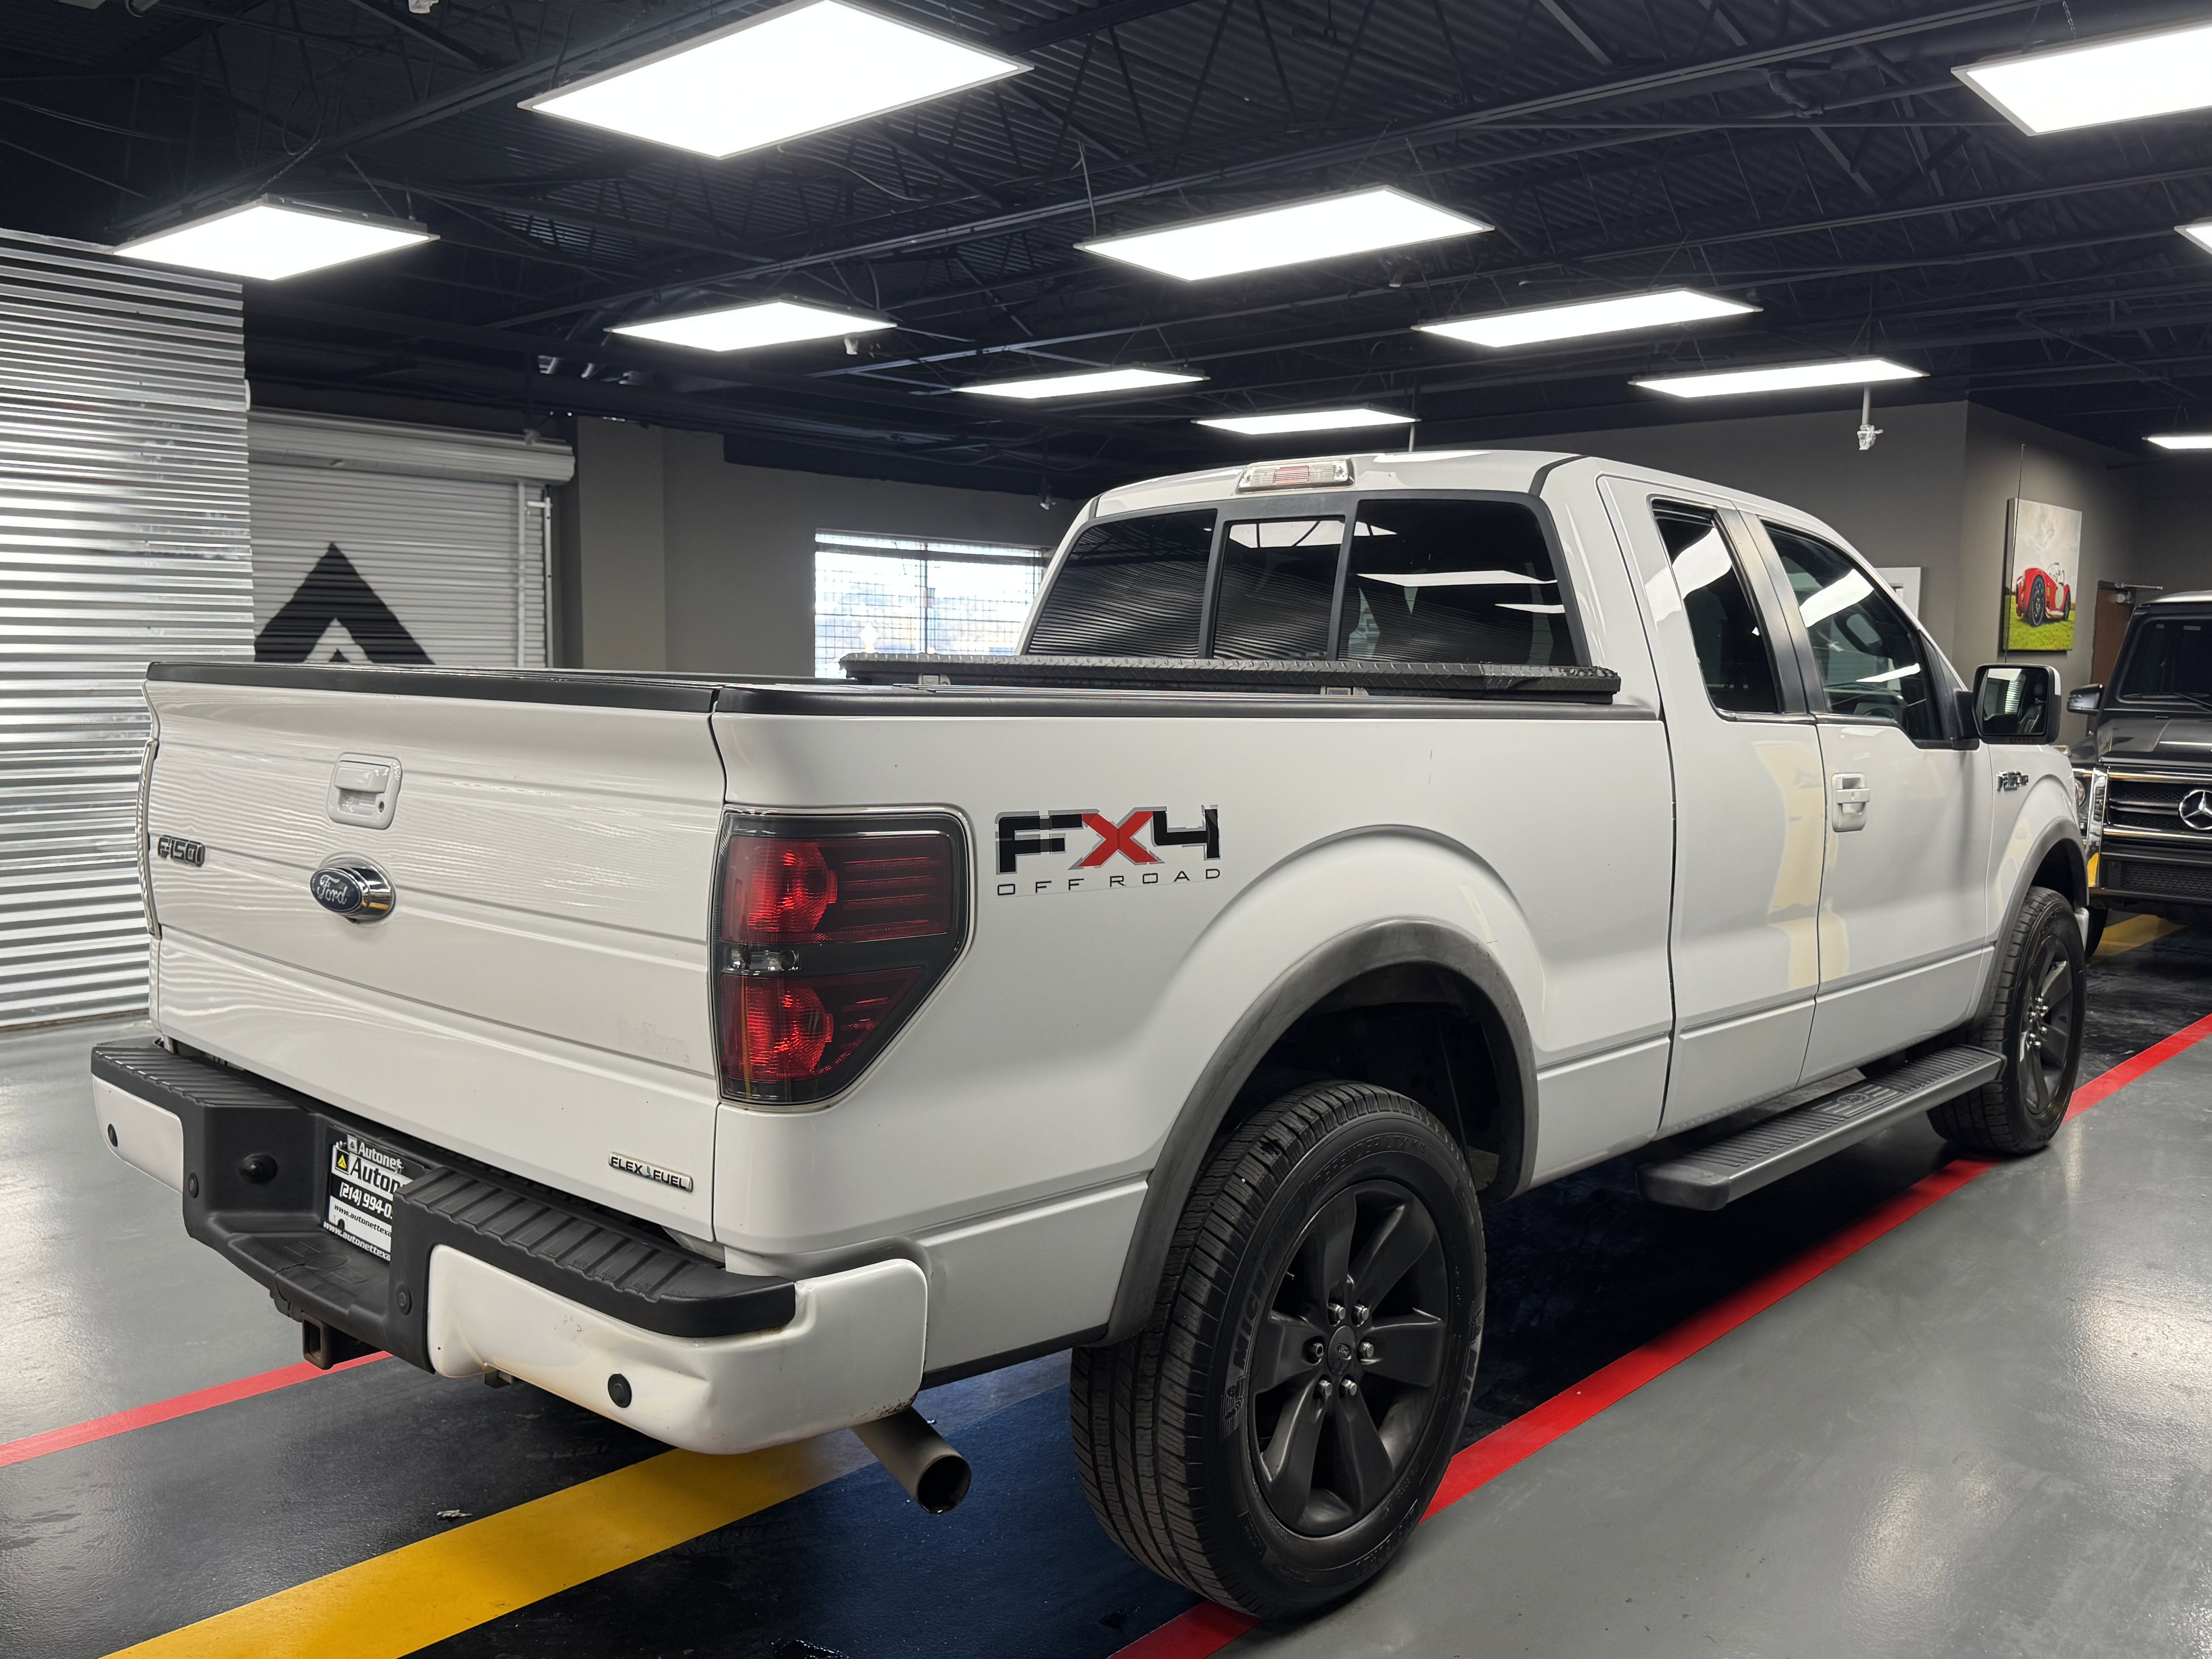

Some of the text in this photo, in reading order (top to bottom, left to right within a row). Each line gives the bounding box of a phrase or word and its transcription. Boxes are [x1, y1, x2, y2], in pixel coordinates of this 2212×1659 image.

[995, 804, 1221, 874] FX4
[317, 874, 348, 905] Ford
[358, 1141, 402, 1171] Autonet
[611, 1156, 687, 1190] FLEX FUEL
[350, 1156, 405, 1194] Auton
[339, 1182, 393, 1219] (214) 994-0
[1232, 1195, 1303, 1370] MICHEL
